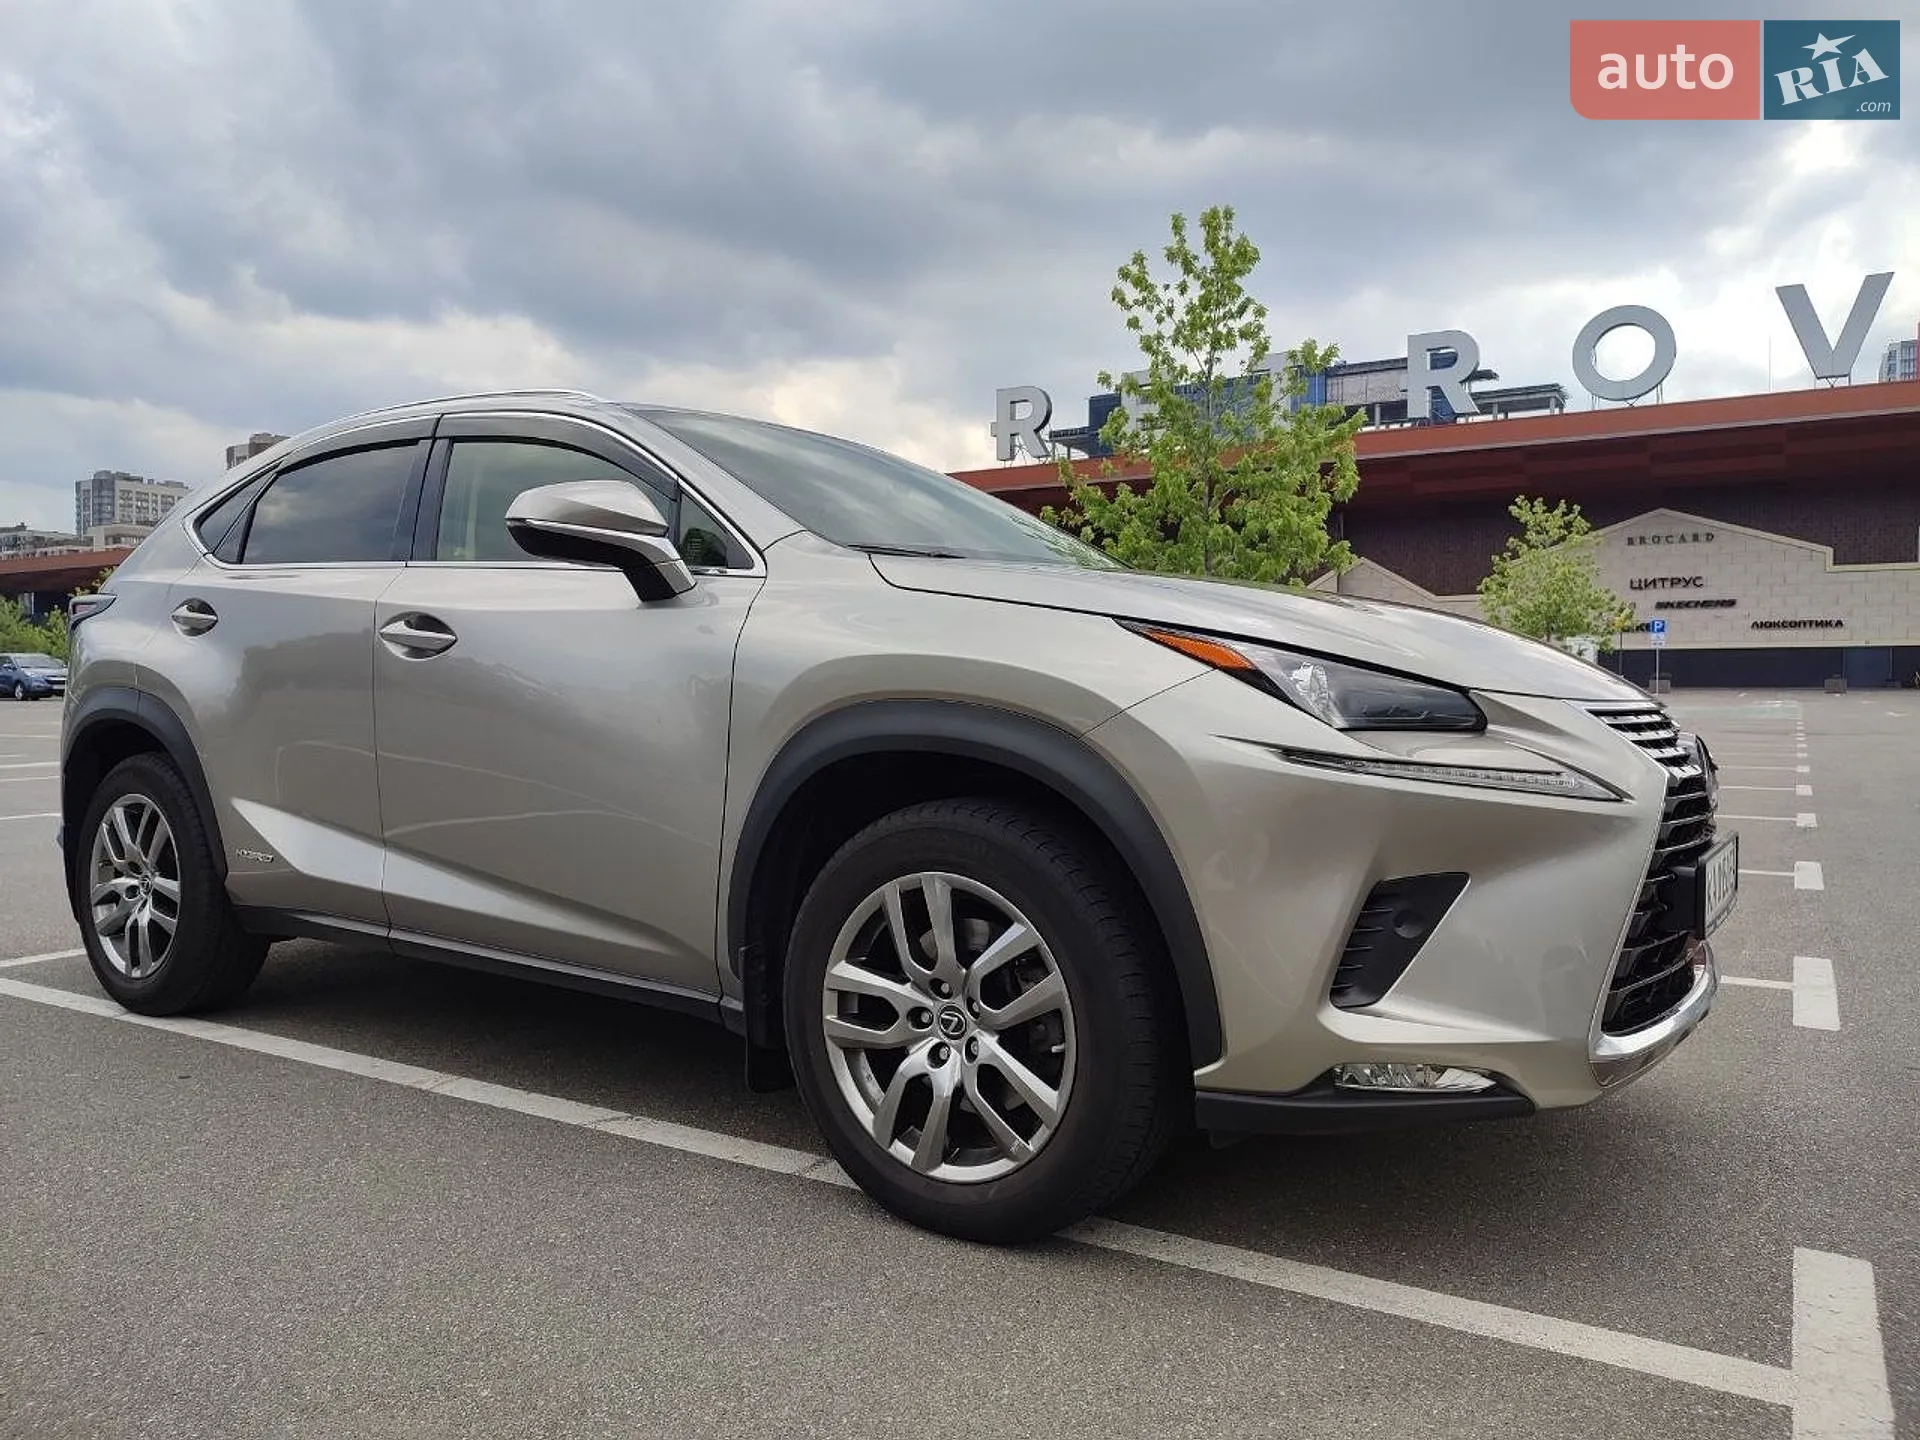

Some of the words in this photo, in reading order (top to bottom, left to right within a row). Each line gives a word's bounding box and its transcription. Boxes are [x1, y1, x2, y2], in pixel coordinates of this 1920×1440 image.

[1627, 532, 1715, 546] BROCARD
[1630, 576, 1704, 591] ЦИТРУС
[1655, 599, 1738, 610] SKECHERS
[1751, 619, 1844, 630] ЛЮКСОПТИКА
